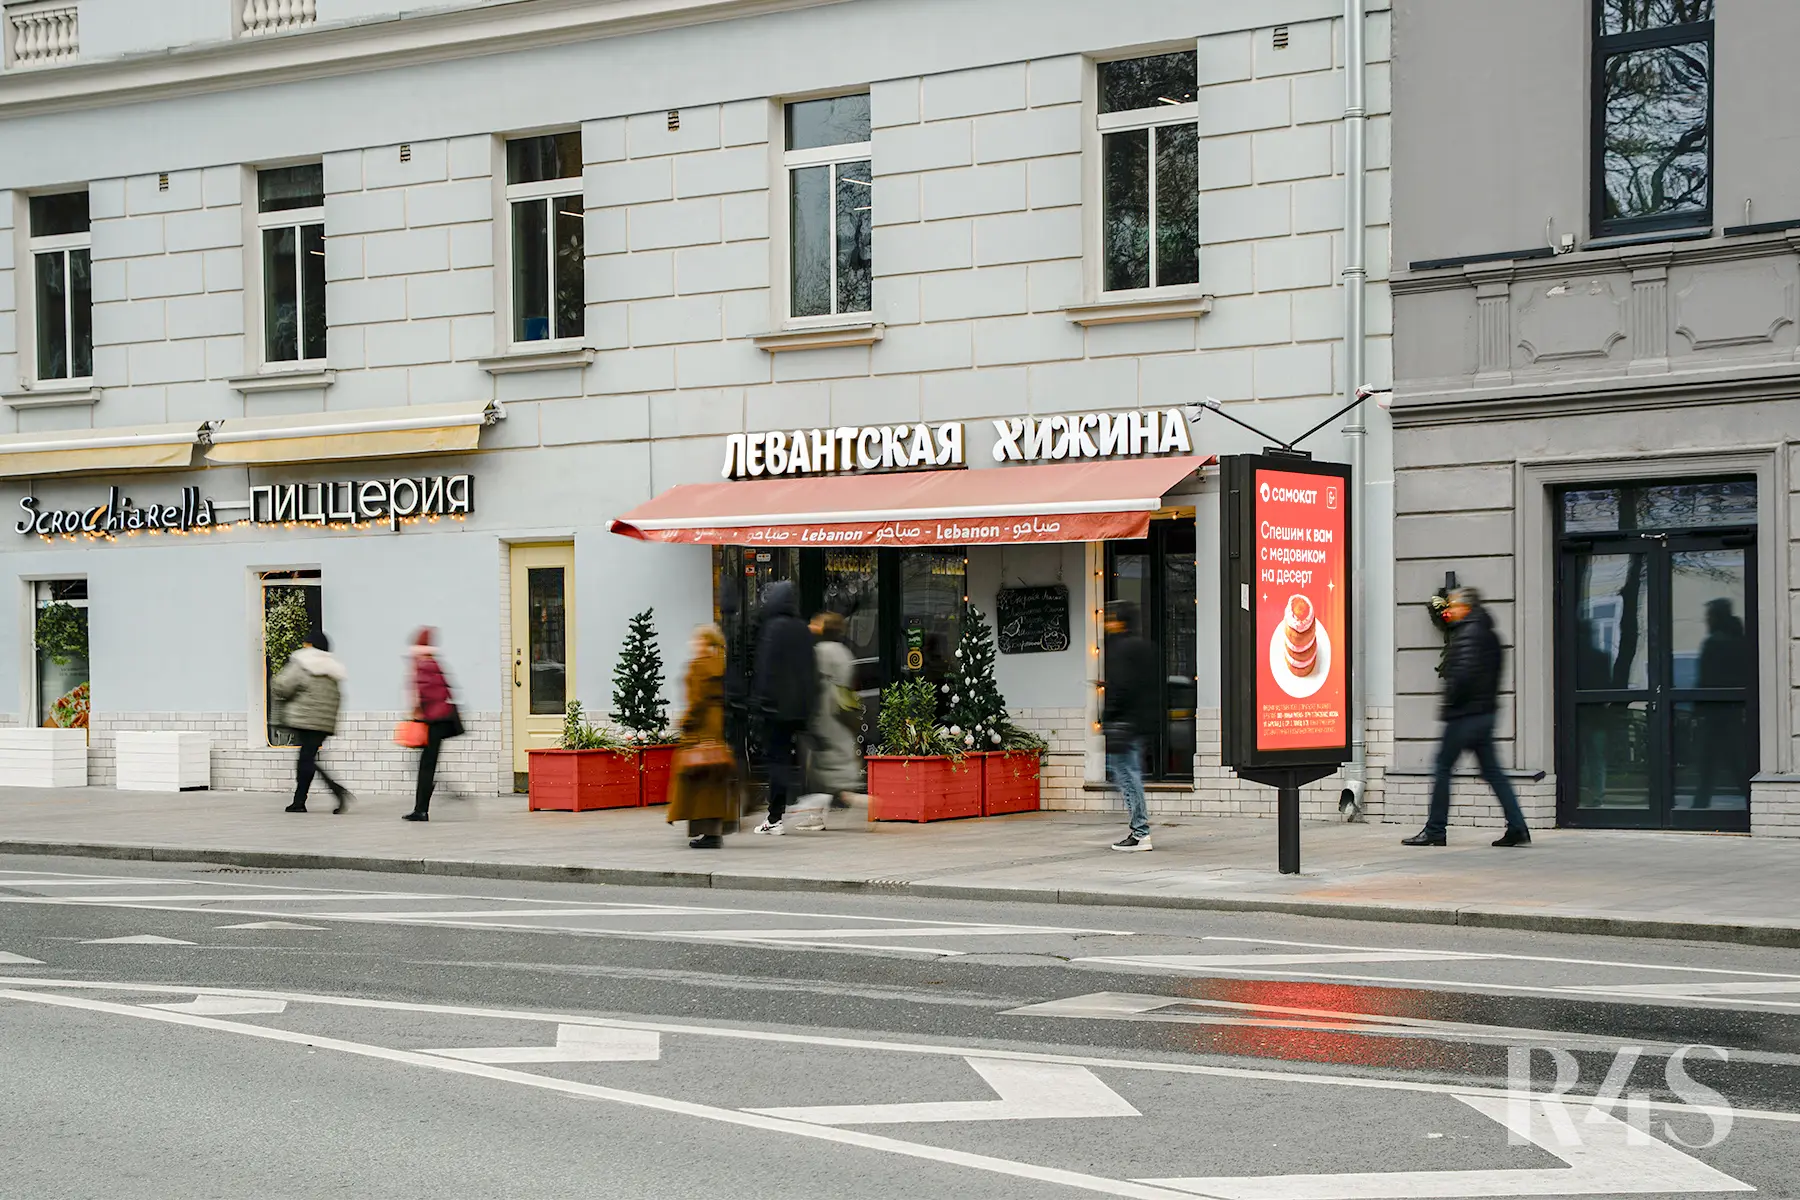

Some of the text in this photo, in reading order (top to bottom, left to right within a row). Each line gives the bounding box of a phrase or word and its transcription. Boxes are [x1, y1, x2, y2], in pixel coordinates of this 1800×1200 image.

[721, 408, 1193, 480] ЛЕВАНТСКАЯ ХИЖИНА
[1271, 487, 1317, 504] самокат
[801, 528, 863, 542] Lebanon
[936, 523, 1000, 540] Lebanon
[1261, 520, 1333, 543] Спешим к вам
[1261, 547, 1326, 564] с медовиком
[1261, 568, 1313, 588] на десерт
